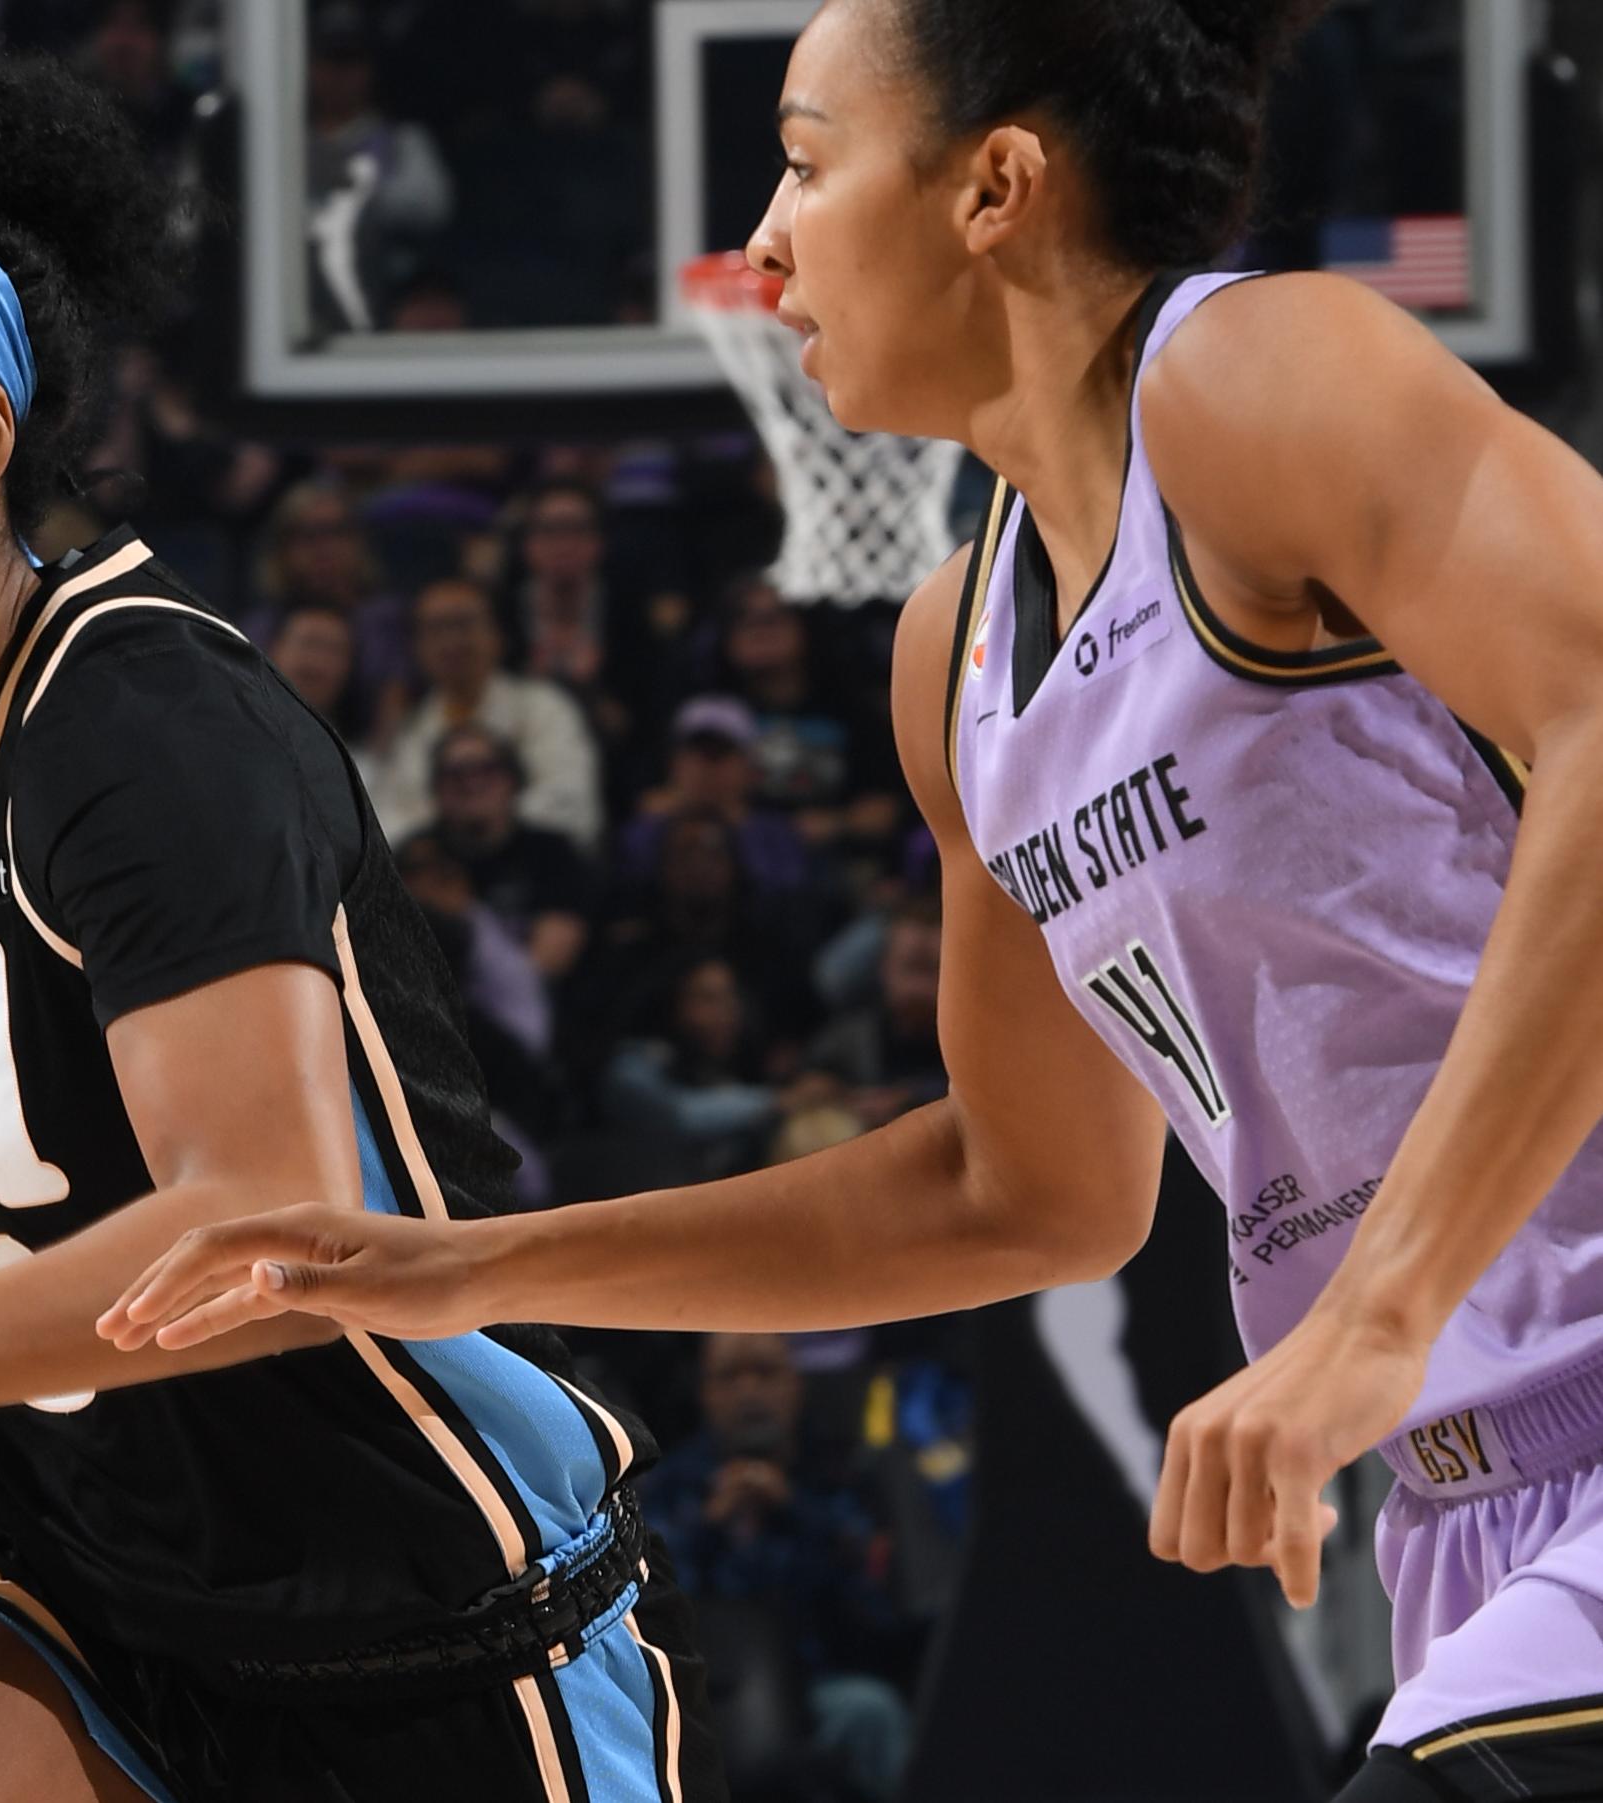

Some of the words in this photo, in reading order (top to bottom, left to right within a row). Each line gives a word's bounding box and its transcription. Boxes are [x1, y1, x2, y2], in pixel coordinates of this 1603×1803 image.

[988, 822, 1084, 926] OLDEN
[1073, 752, 1208, 889] STATE
[1081, 938, 1232, 1130] 41
[1231, 1174, 1307, 1244] KAISER
[1410, 1408, 1493, 1484] GSV
